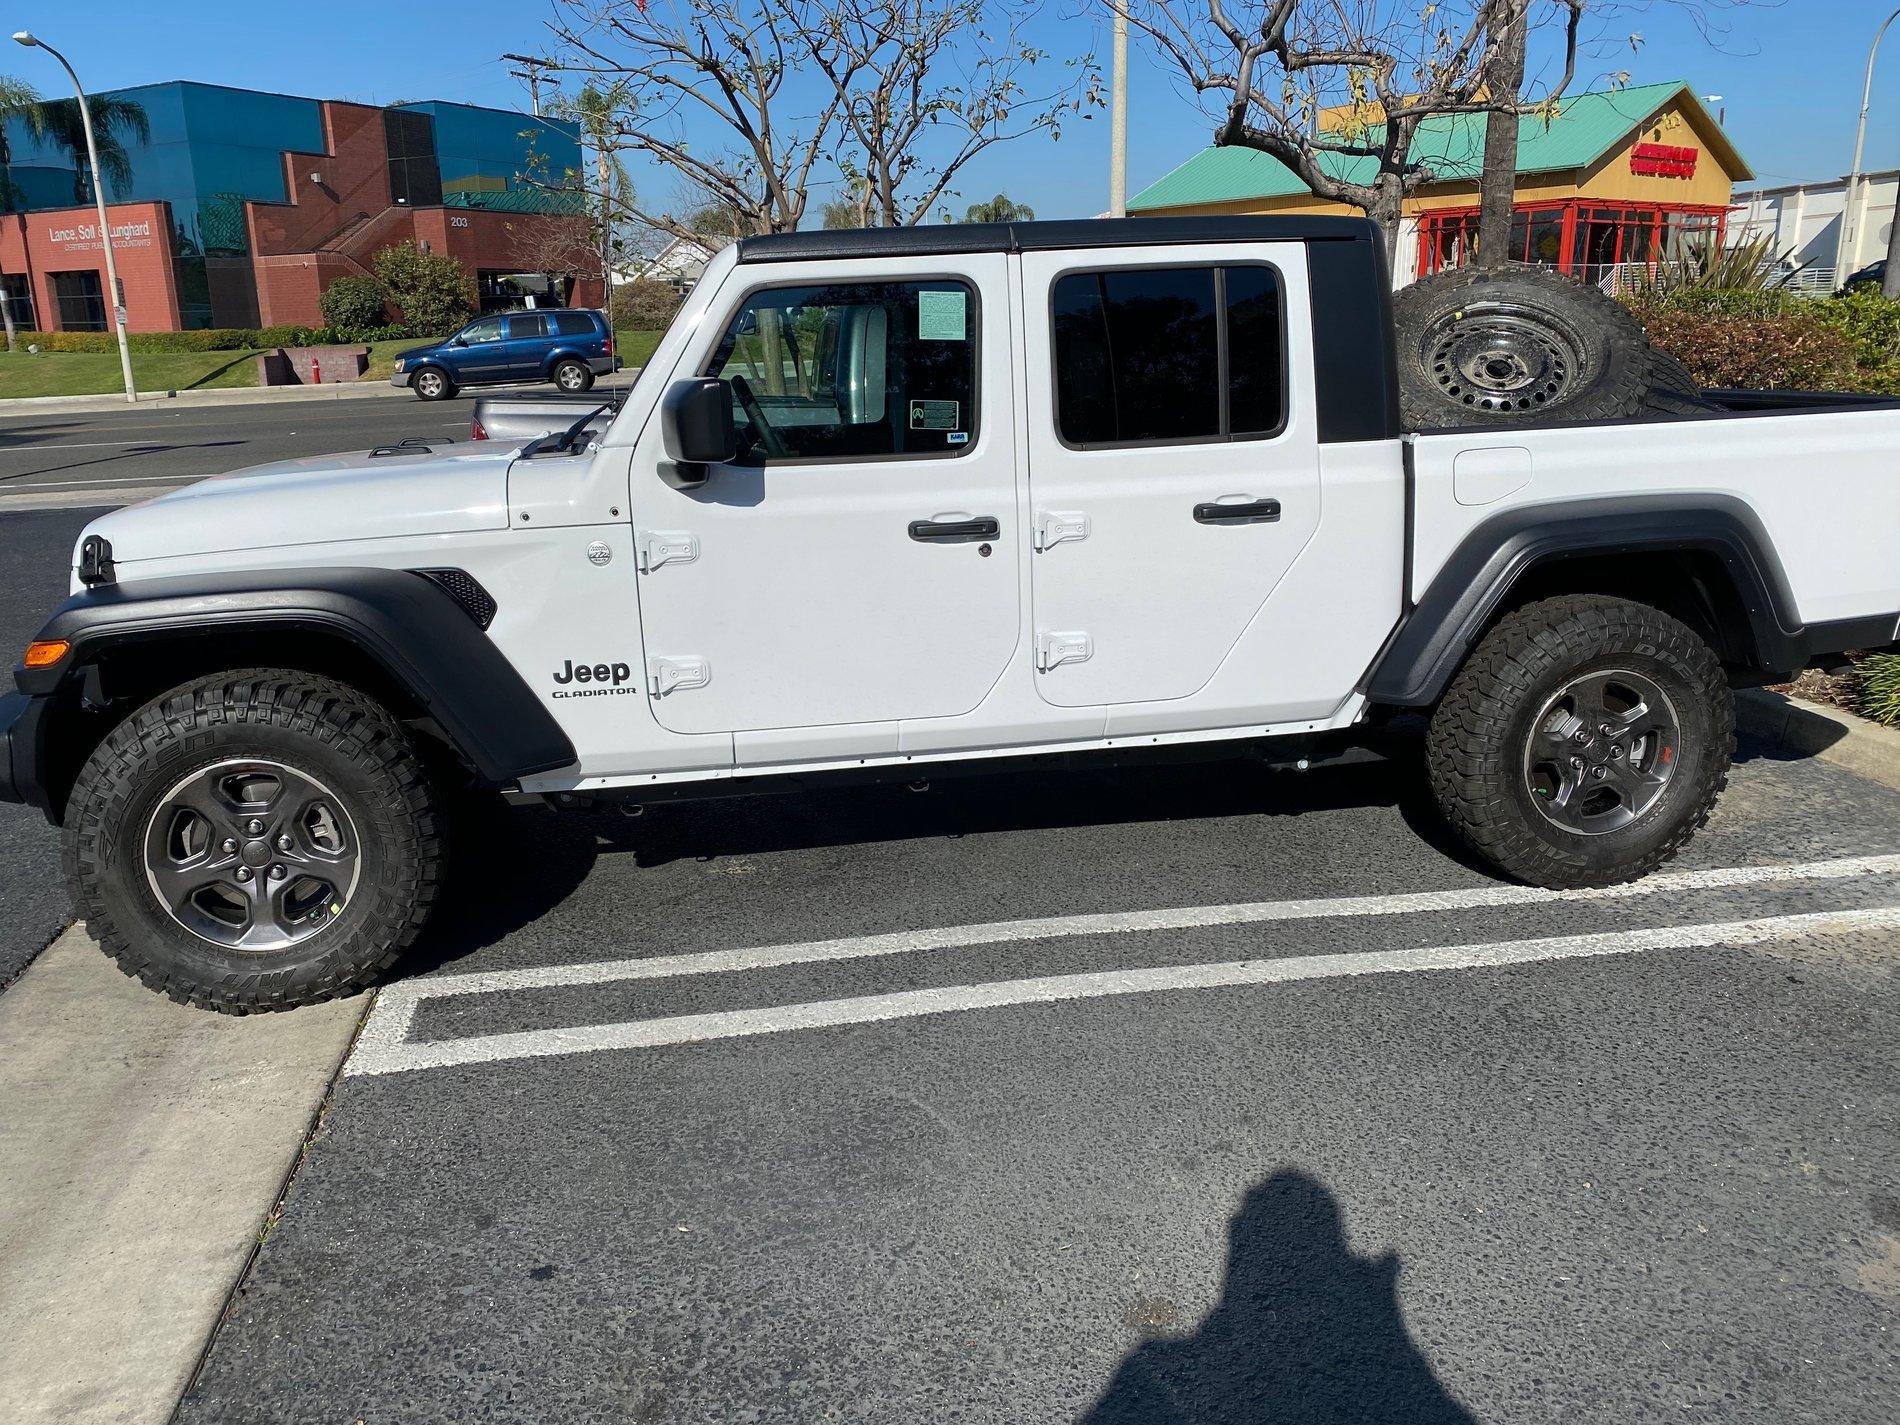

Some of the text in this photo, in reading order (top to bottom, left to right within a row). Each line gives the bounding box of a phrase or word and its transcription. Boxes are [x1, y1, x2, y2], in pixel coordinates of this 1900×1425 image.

[451, 217, 468, 227] 203
[108, 221, 150, 240] Lunghard
[552, 659, 631, 686] Jeep
[552, 687, 637, 699] GLADIATOR
